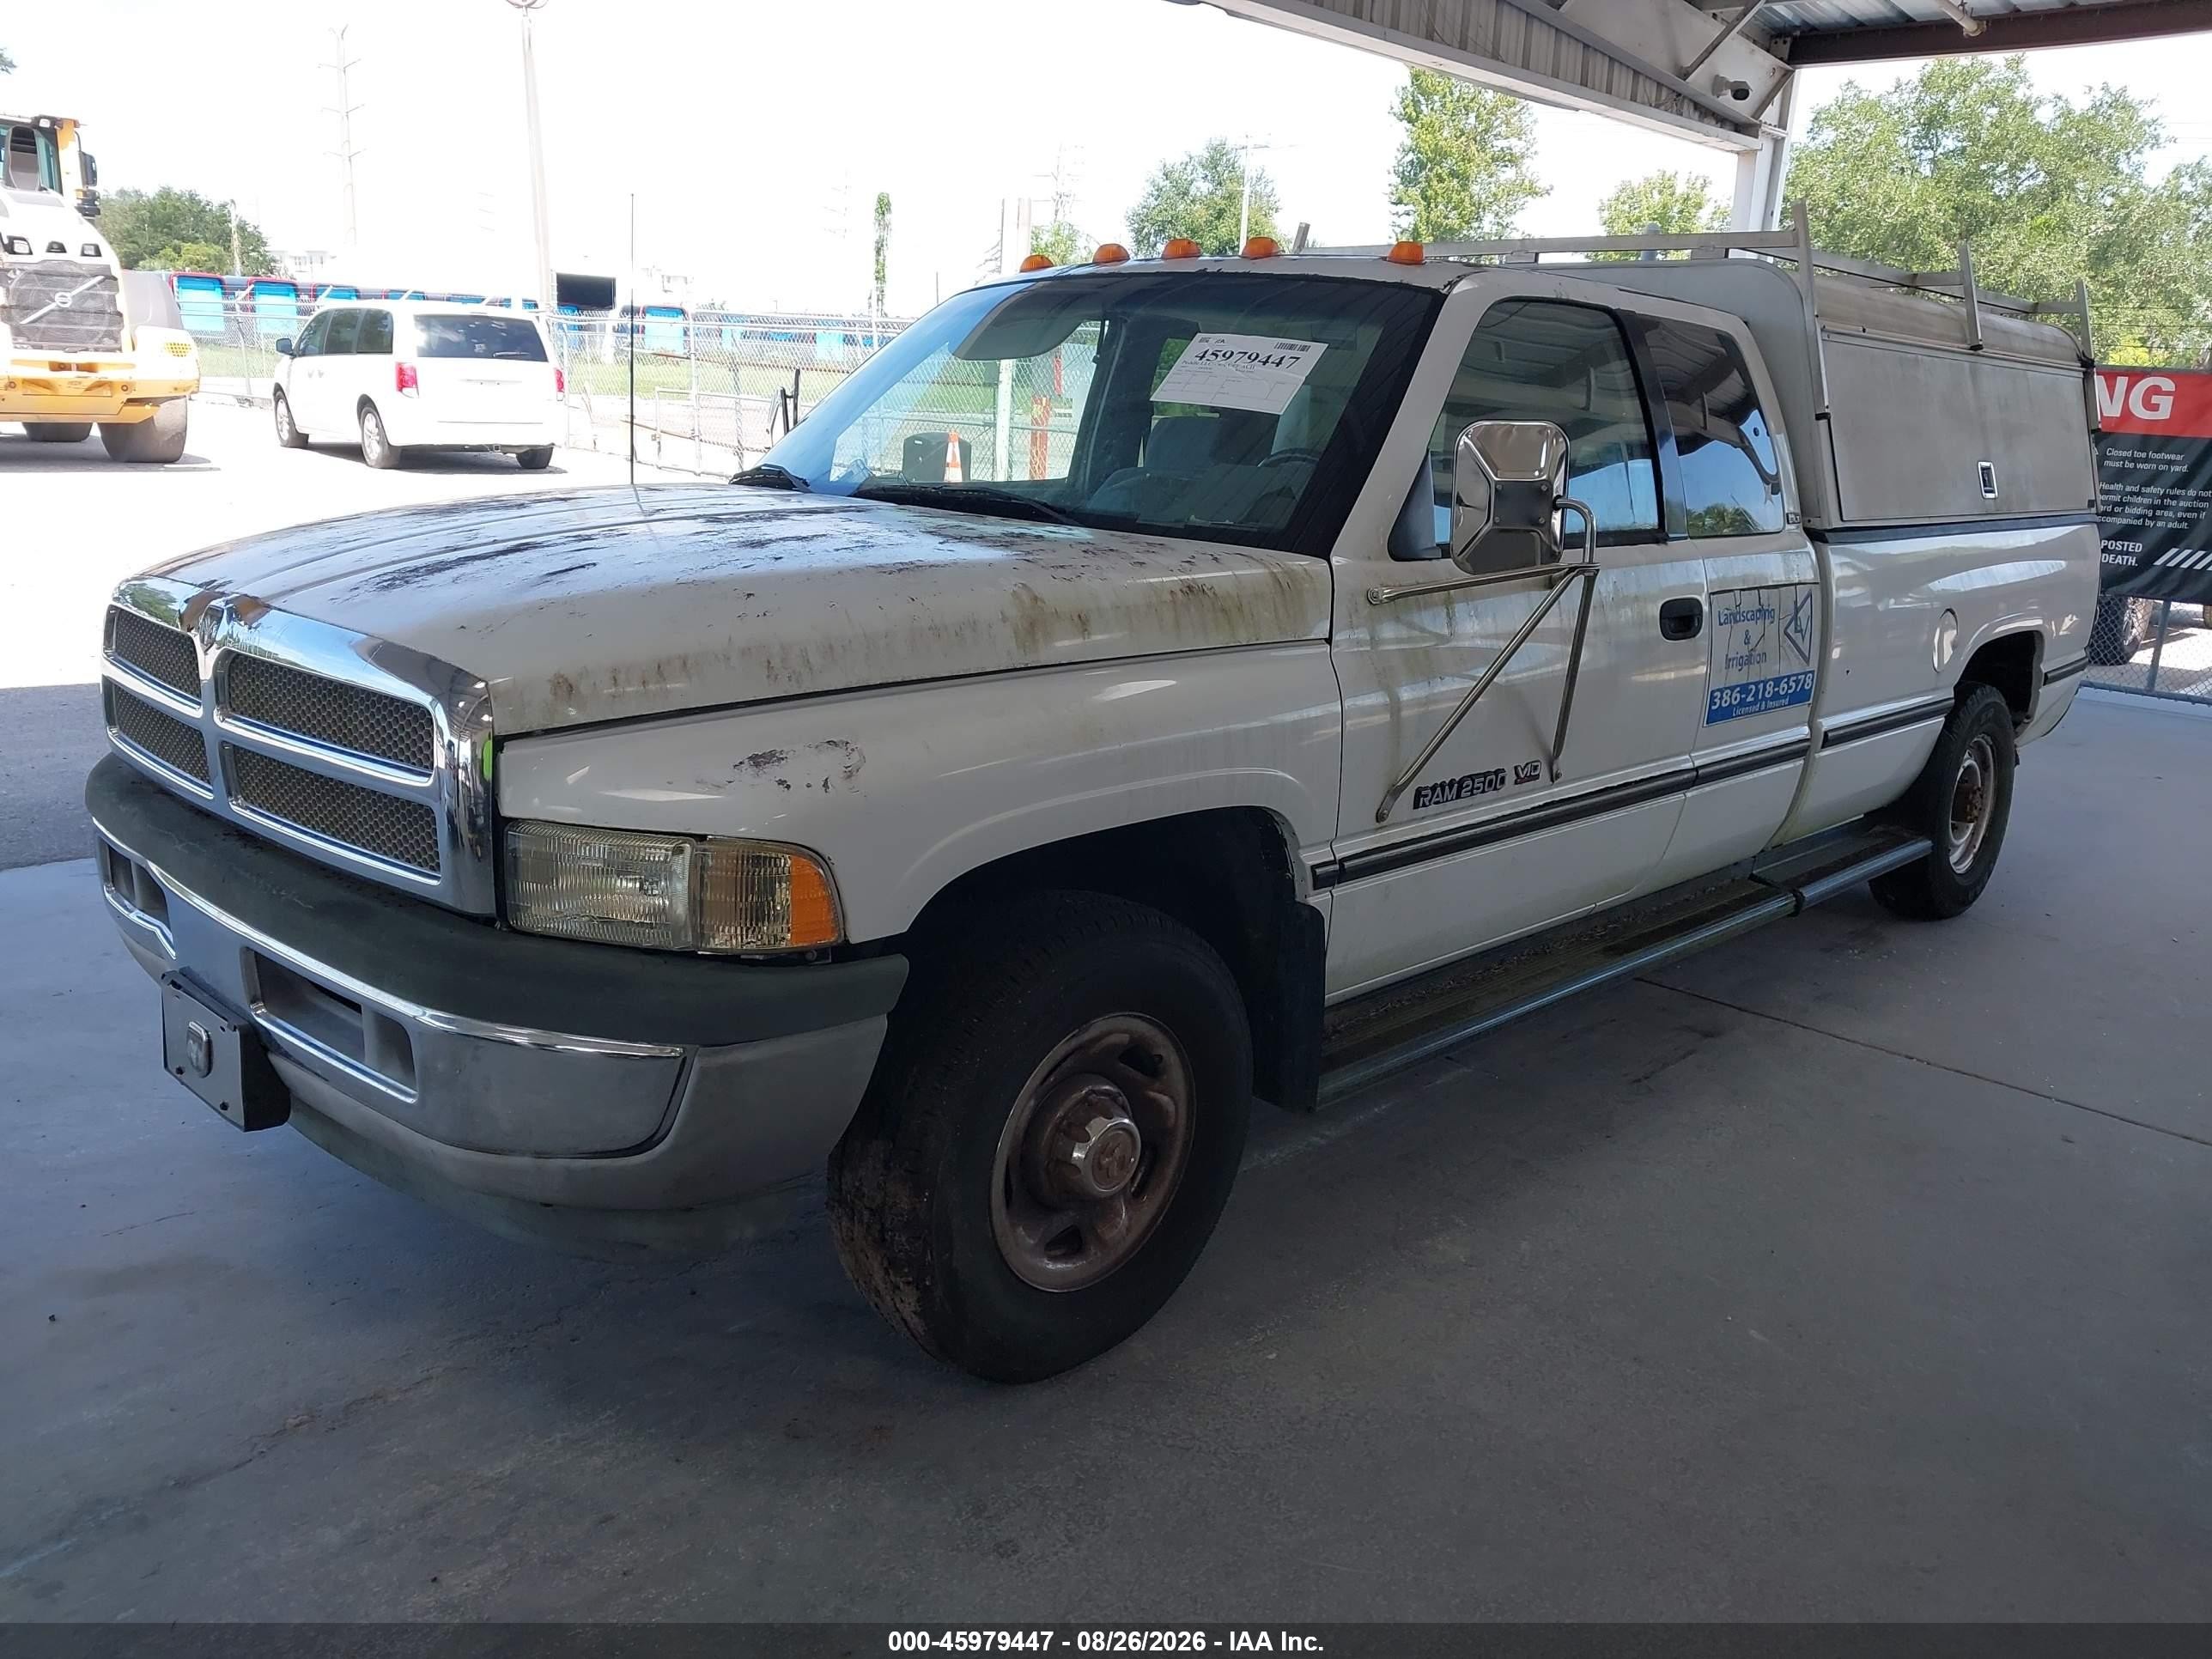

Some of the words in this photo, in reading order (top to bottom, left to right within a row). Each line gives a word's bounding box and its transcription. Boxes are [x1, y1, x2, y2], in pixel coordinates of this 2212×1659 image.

[1194, 349, 1302, 369] 45979447
[2106, 448, 2132, 458] Closed
[2148, 451, 2185, 461] footwear
[2104, 459, 2124, 468] must
[2124, 460, 2135, 469] be
[2136, 462, 2157, 471] worn
[2170, 465, 2189, 473] yard.
[2100, 482, 2124, 491] Health
[2125, 484, 2140, 493] and
[2141, 486, 2165, 495] safety
[2122, 495, 2153, 505] children
[2164, 498, 2177, 507] the
[2179, 501, 2209, 509] auction
[2124, 506, 2153, 516] bidding
[2199, 511, 2206, 520] if
[2097, 515, 2143, 526] ccompanied
[2144, 518, 2155, 528] by
[2101, 539, 2142, 552] POSTED
[2101, 553, 2138, 566] DEATH.
[1718, 605, 1775, 626] Landscaping
[1744, 629, 1752, 645] &
[1725, 652, 1767, 672] Irrigation
[1711, 672, 1814, 710] 386-218-6578
[1418, 783, 1457, 807] RAM
